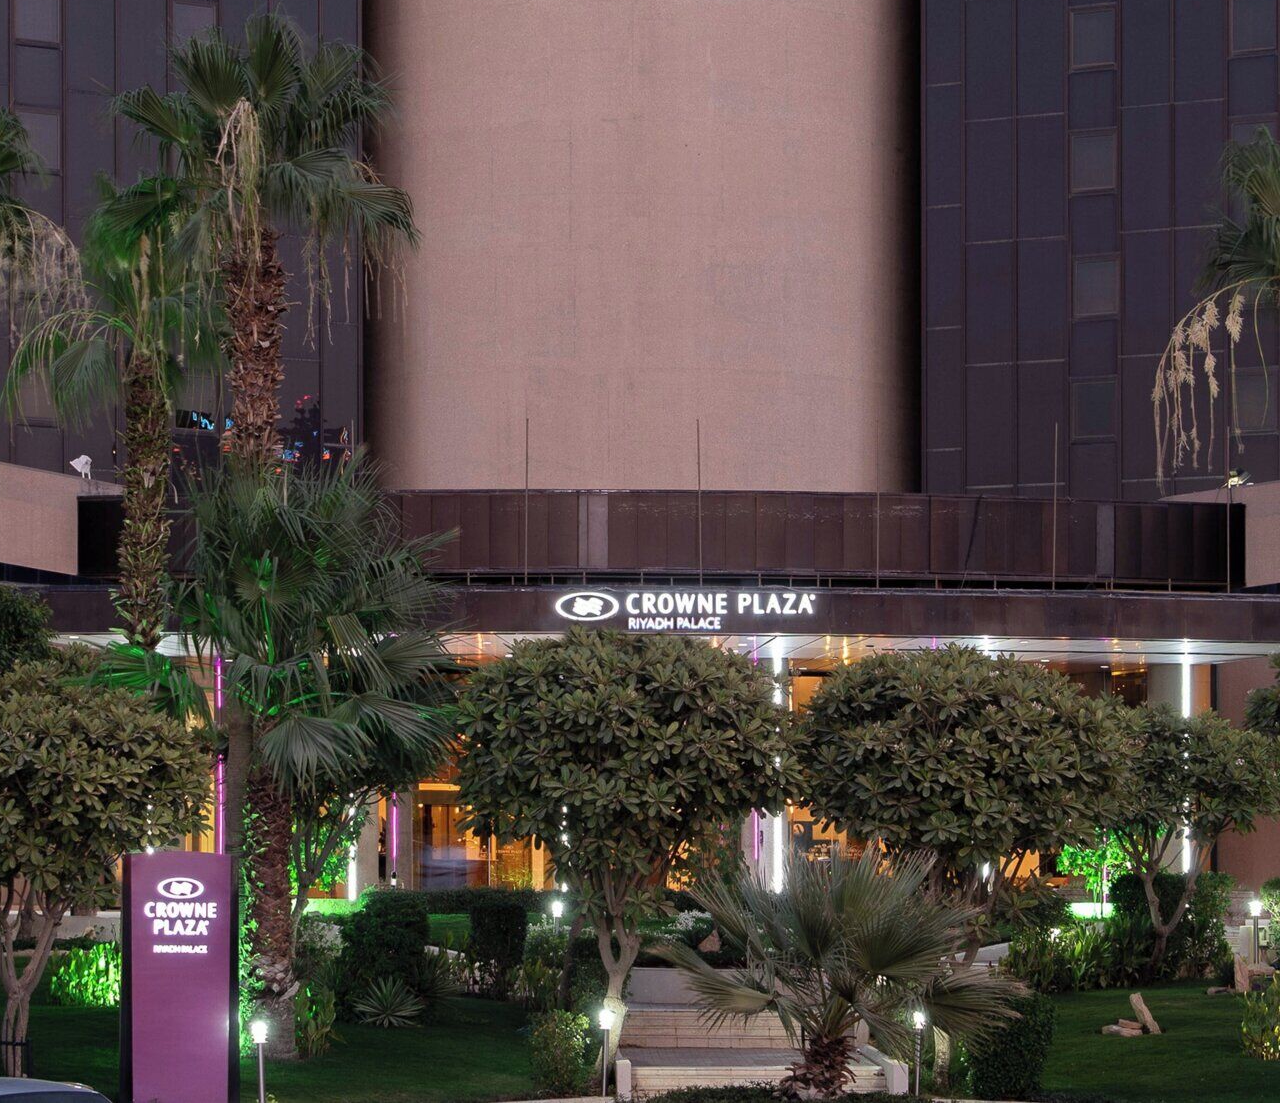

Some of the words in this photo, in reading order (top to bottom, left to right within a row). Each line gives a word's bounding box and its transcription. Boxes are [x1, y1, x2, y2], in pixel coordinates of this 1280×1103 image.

[625, 592, 728, 615] CROWNE
[737, 592, 816, 615] PLAZA
[628, 616, 674, 631] RIYADH
[676, 616, 722, 630] PALACE
[143, 901, 218, 919] CROWNE
[153, 918, 210, 936] PLAZA
